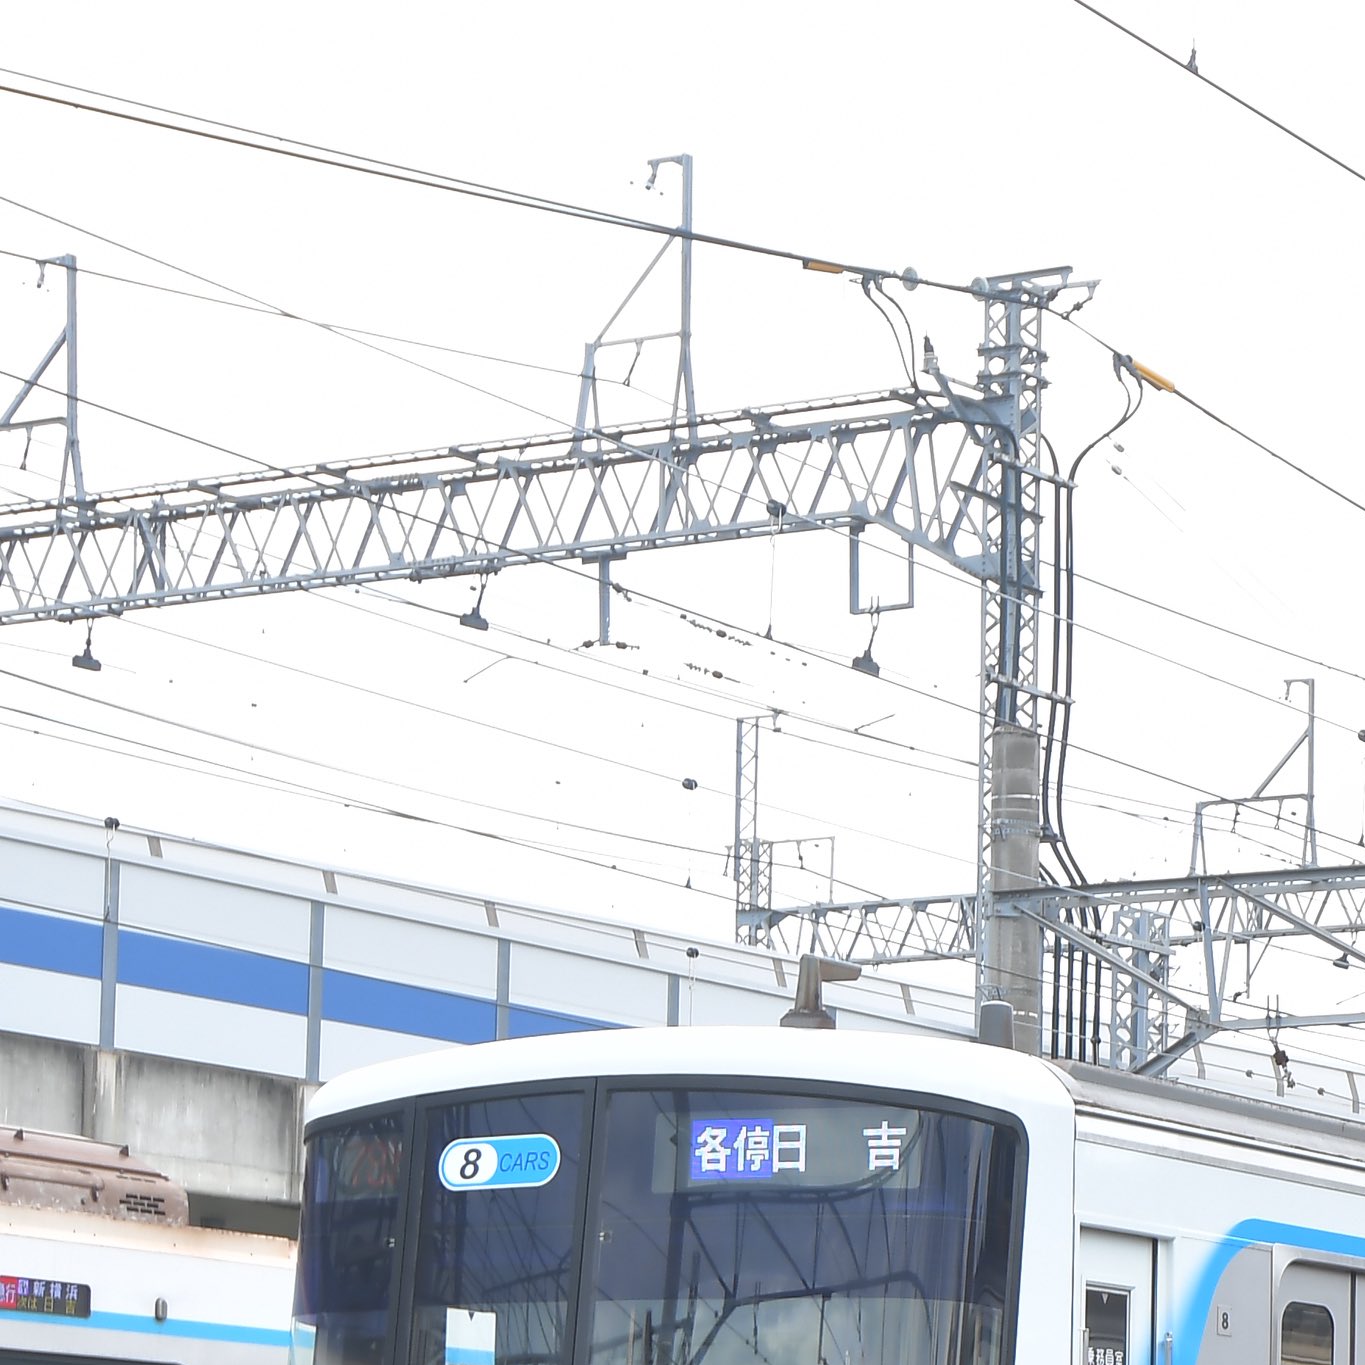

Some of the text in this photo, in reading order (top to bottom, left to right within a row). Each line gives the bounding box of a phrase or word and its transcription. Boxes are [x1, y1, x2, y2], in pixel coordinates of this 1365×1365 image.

[460, 1148, 550, 1180] 8 CARS
[695, 1125, 770, 1173] 各停
[1221, 1311, 1229, 1330] 8
